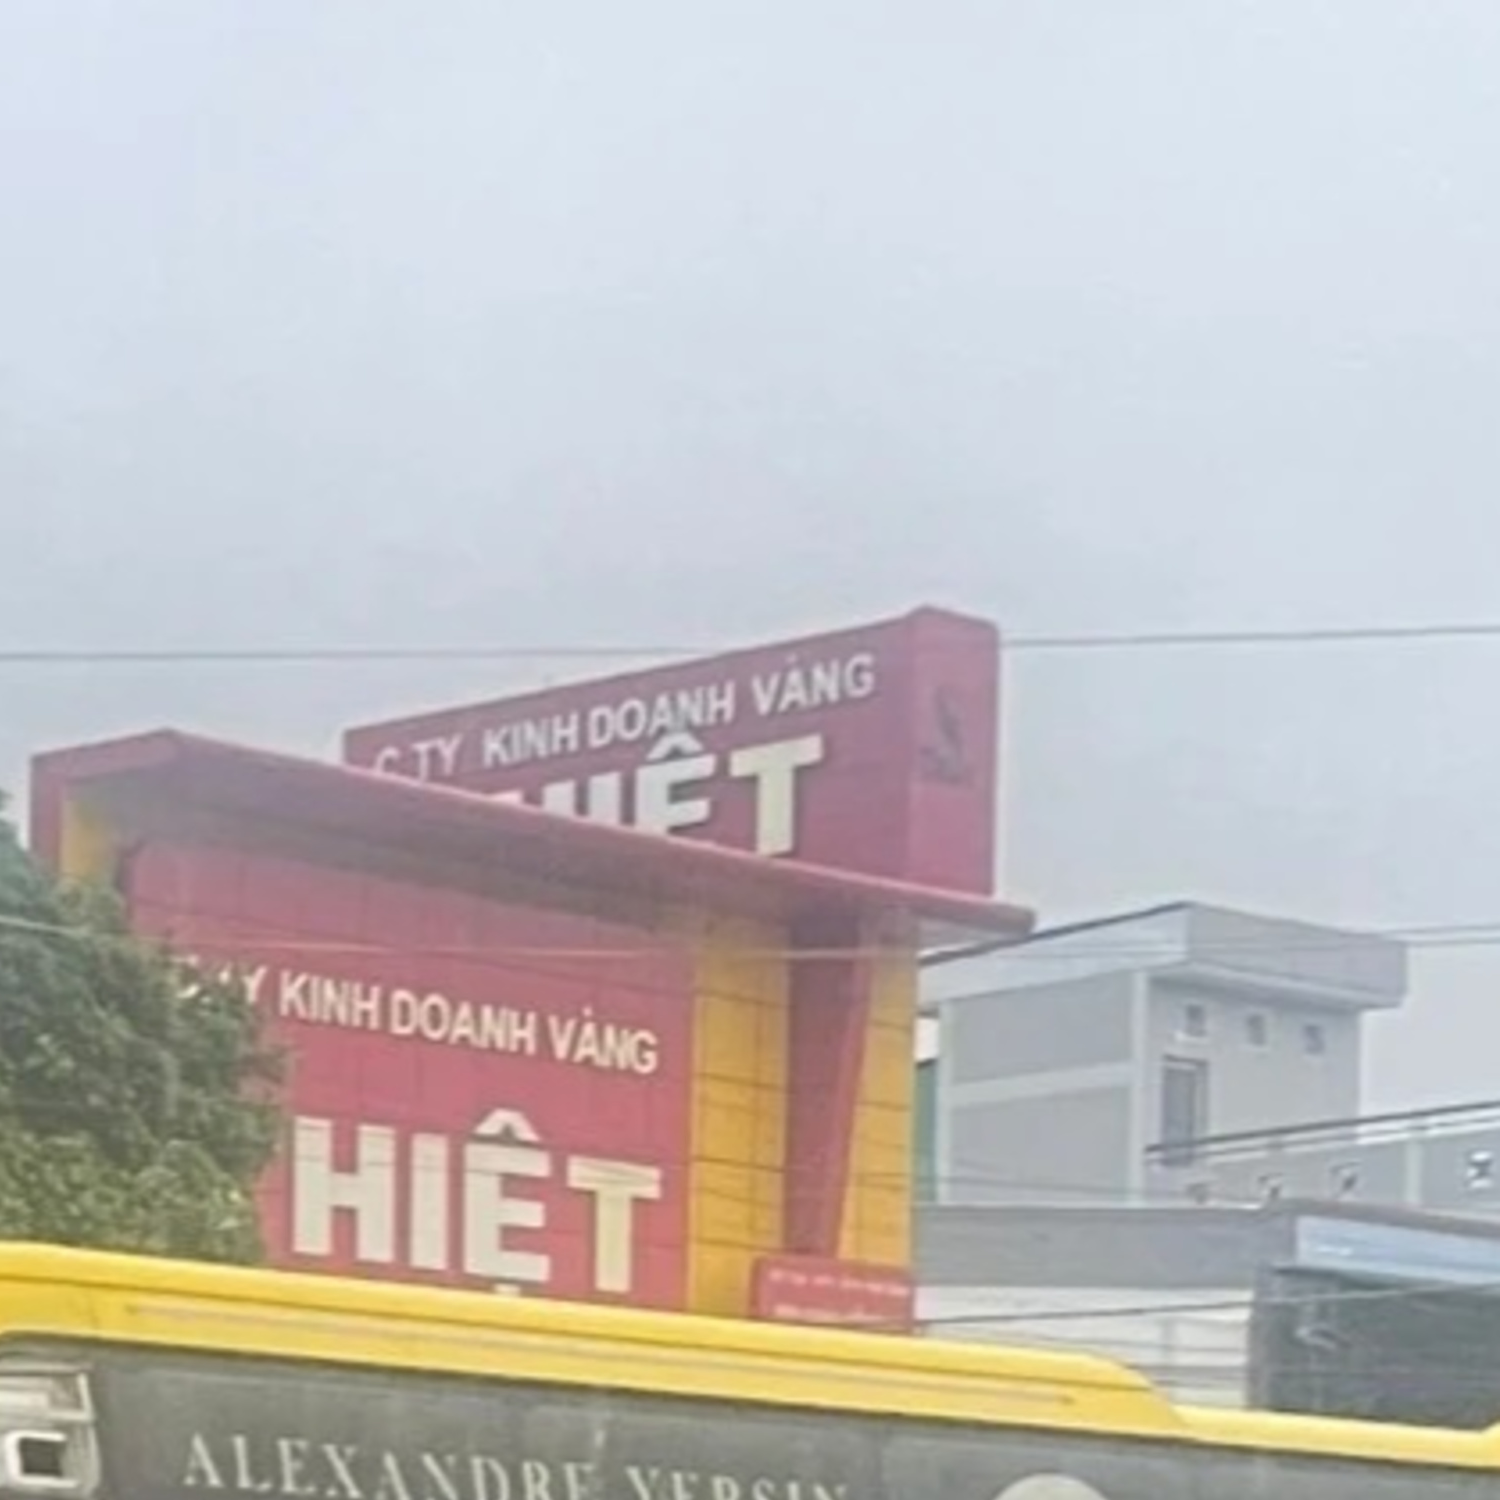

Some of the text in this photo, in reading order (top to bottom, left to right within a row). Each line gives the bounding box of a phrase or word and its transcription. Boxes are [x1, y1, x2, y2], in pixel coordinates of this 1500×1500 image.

[483, 711, 579, 767] KINH
[588, 681, 736, 749] DOANH
[279, 970, 380, 1031] KINH
[390, 990, 537, 1054] DOANH
